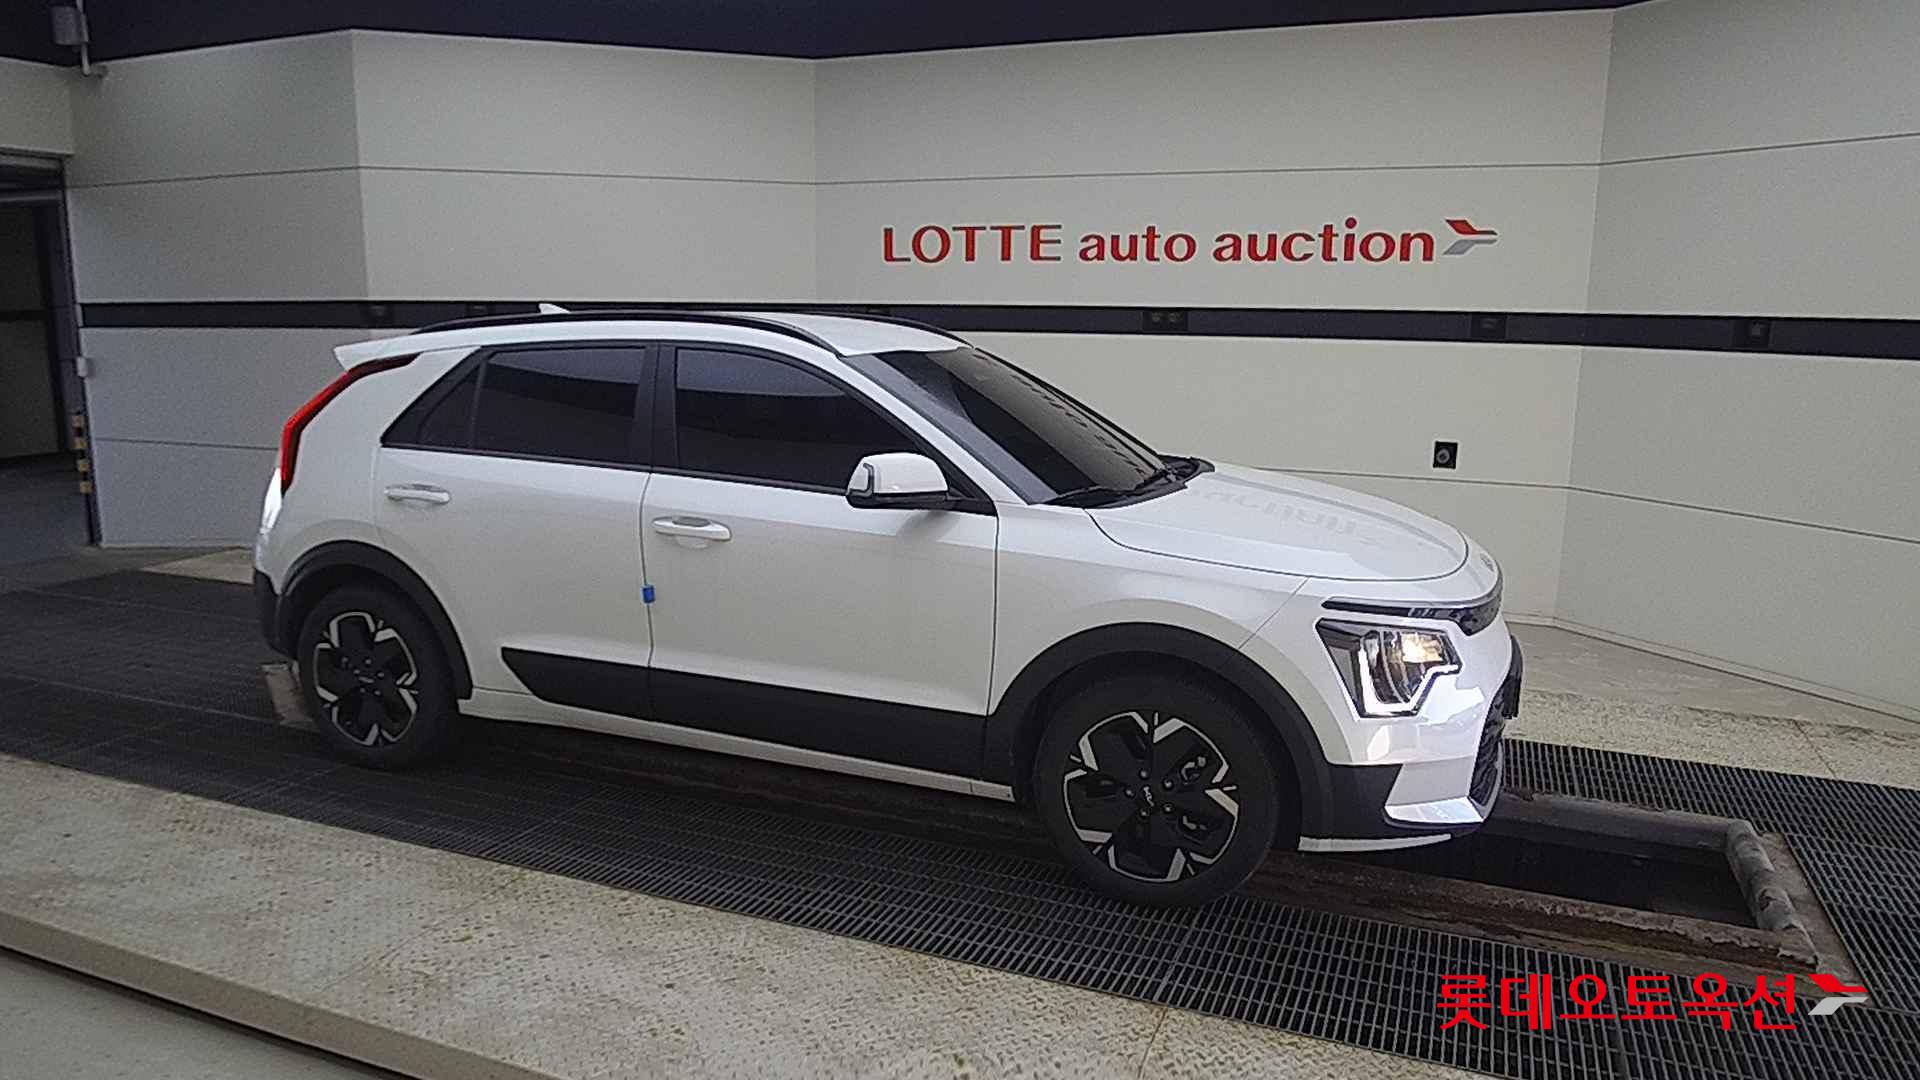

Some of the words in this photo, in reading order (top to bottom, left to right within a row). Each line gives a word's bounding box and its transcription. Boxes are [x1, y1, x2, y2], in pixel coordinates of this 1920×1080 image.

[883, 224, 1062, 262] LOTTE
[1079, 225, 1196, 262] auto
[1212, 218, 1435, 262] auction
